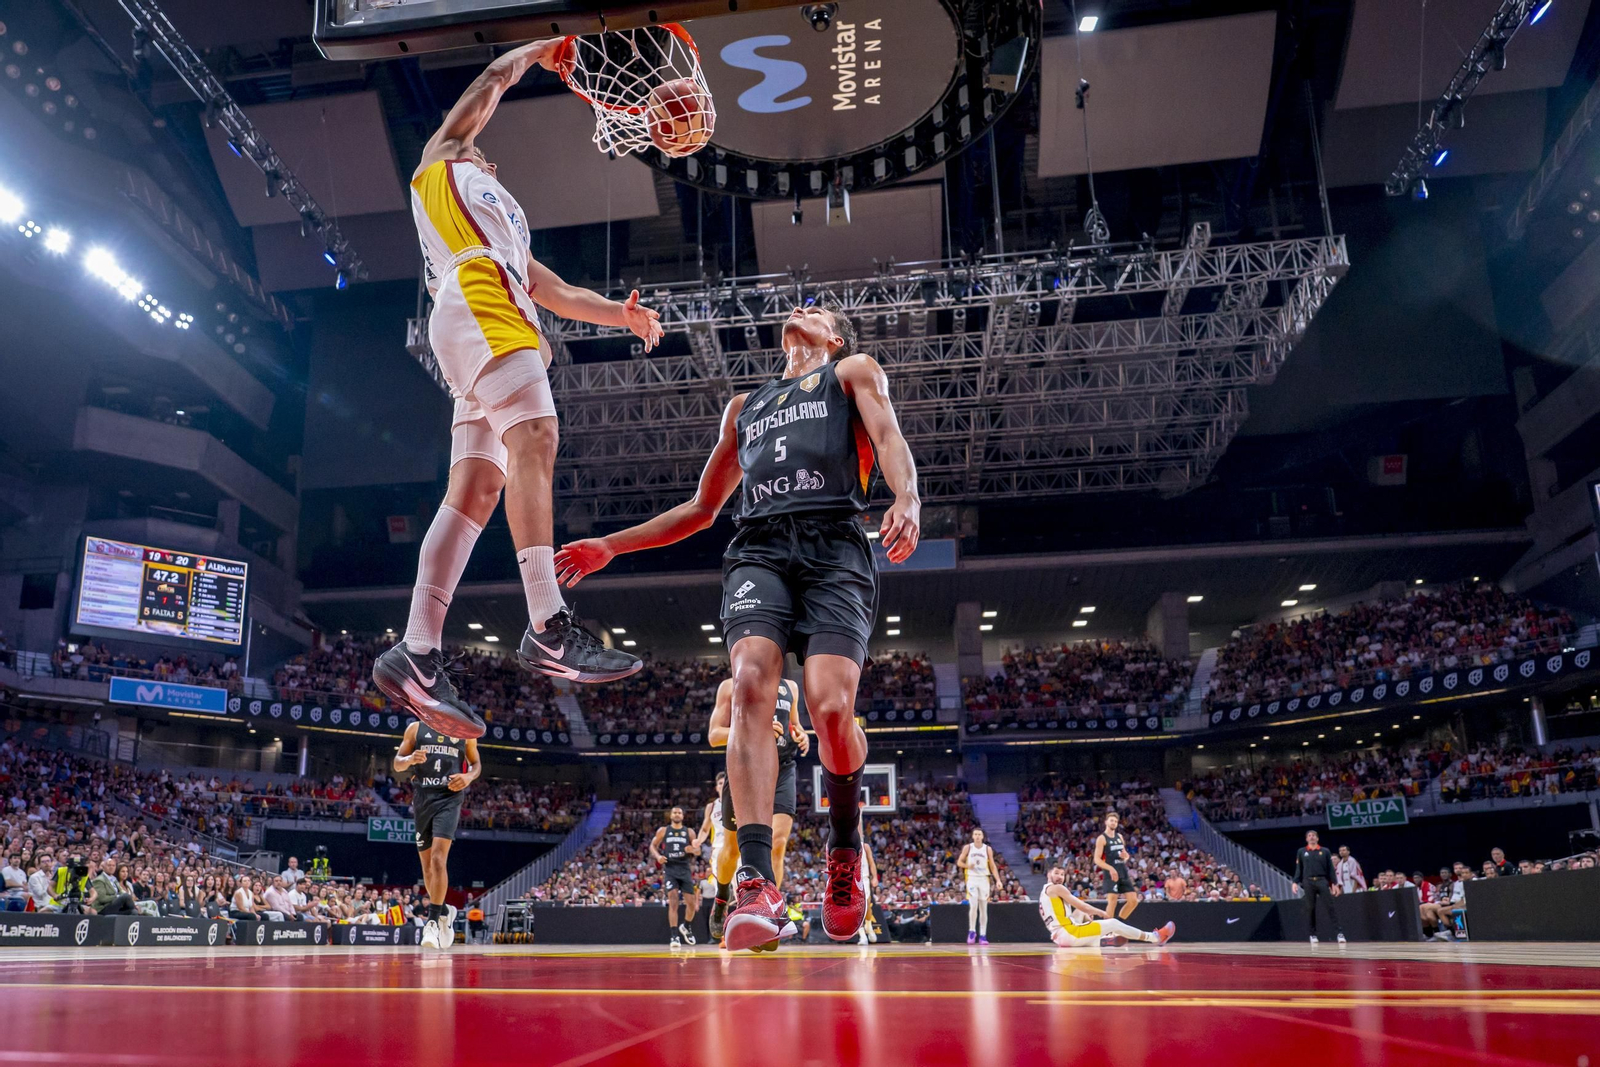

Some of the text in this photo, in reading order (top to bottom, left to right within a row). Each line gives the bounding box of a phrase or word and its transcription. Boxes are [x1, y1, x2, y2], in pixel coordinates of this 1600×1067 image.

[830, 21, 857, 111] Movistar
[864, 18, 882, 105] ARENA
[745, 401, 828, 446] DEUTSCHLAND
[774, 435, 788, 463] 5
[751, 475, 791, 505] ING
[148, 551, 161, 562] 19
[175, 556, 189, 566] 20
[207, 562, 245, 574] ALEMANIA
[152, 569, 179, 583] 47.2
[729, 597, 762, 610] Domino's
[734, 603, 757, 612] Pizza
[143, 606, 184, 620] 5 FALTAS 5
[167, 688, 204, 699] Movistar
[167, 697, 202, 706] ARENA
[433, 758, 441, 772] 4
[422, 776, 440, 786] ING
[1331, 800, 1400, 817] SALIDA
[372, 819, 415, 832] SALID
[1351, 814, 1381, 827] EXIT
[387, 831, 413, 842] EXIT
[0, 923, 59, 937] LaFamilia
[273, 928, 307, 941] #LaFamilia
